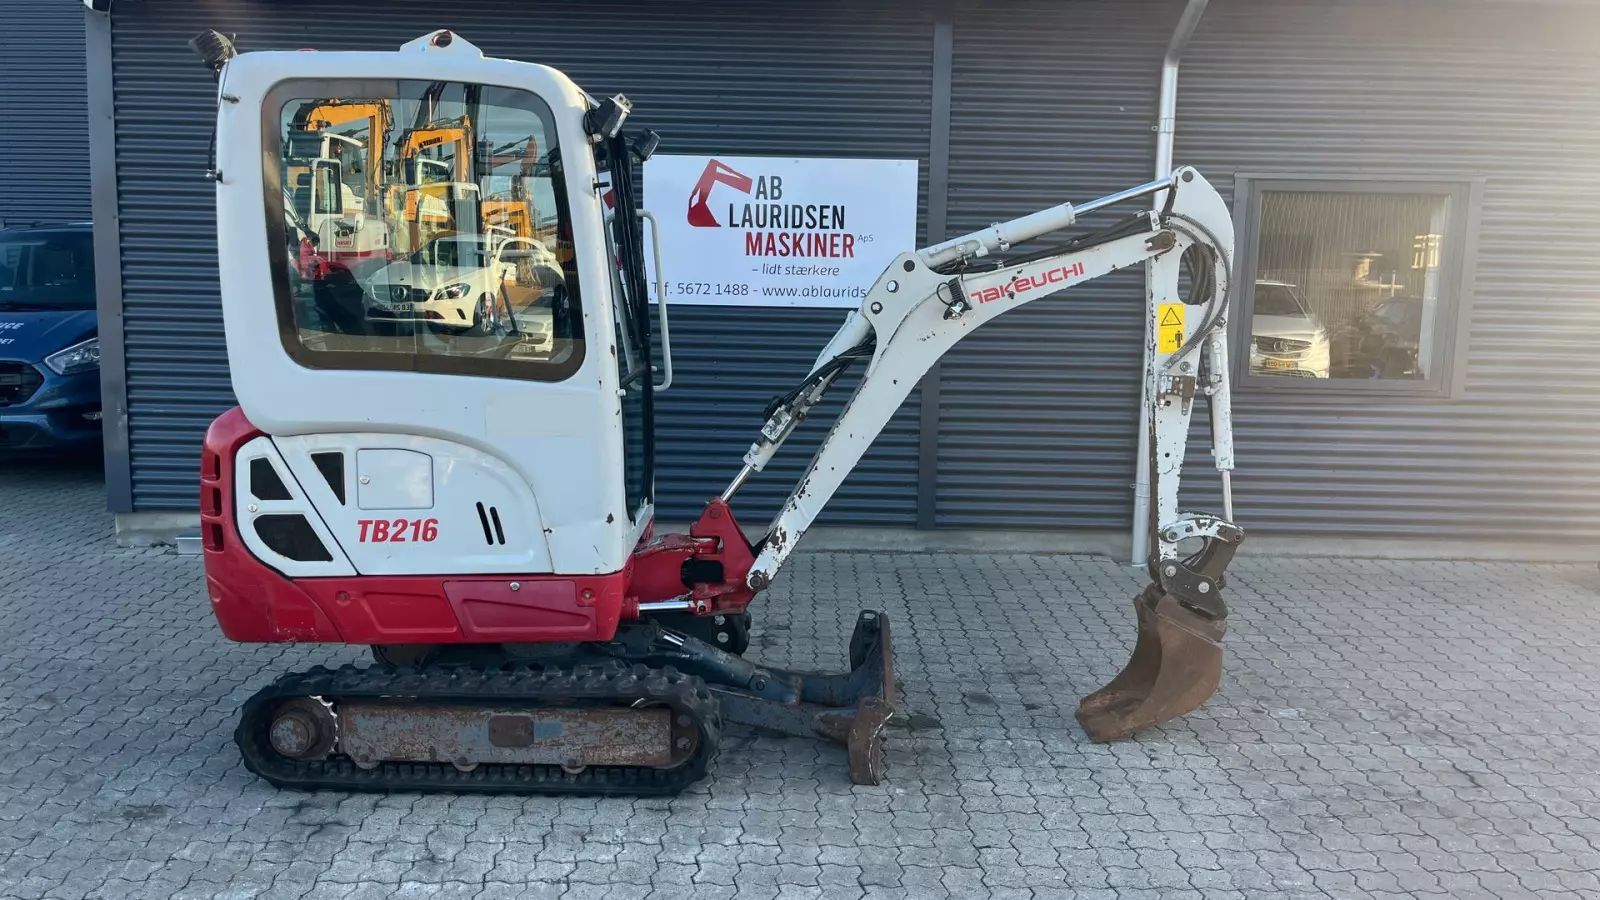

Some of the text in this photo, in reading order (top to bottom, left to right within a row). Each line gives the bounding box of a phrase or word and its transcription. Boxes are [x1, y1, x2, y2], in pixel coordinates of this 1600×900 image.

[755, 175, 783, 200] AB
[729, 203, 845, 229] LAURIDSEN
[745, 232, 874, 258] MASKINER ApS
[762, 263, 782, 275] lidt
[785, 264, 840, 277] stærkere
[651, 281, 673, 297] Tf.
[677, 282, 711, 296] 5672
[714, 283, 749, 296] 1488
[971, 262, 1085, 304] TAKEUCHI
[357, 518, 439, 543] TB216
